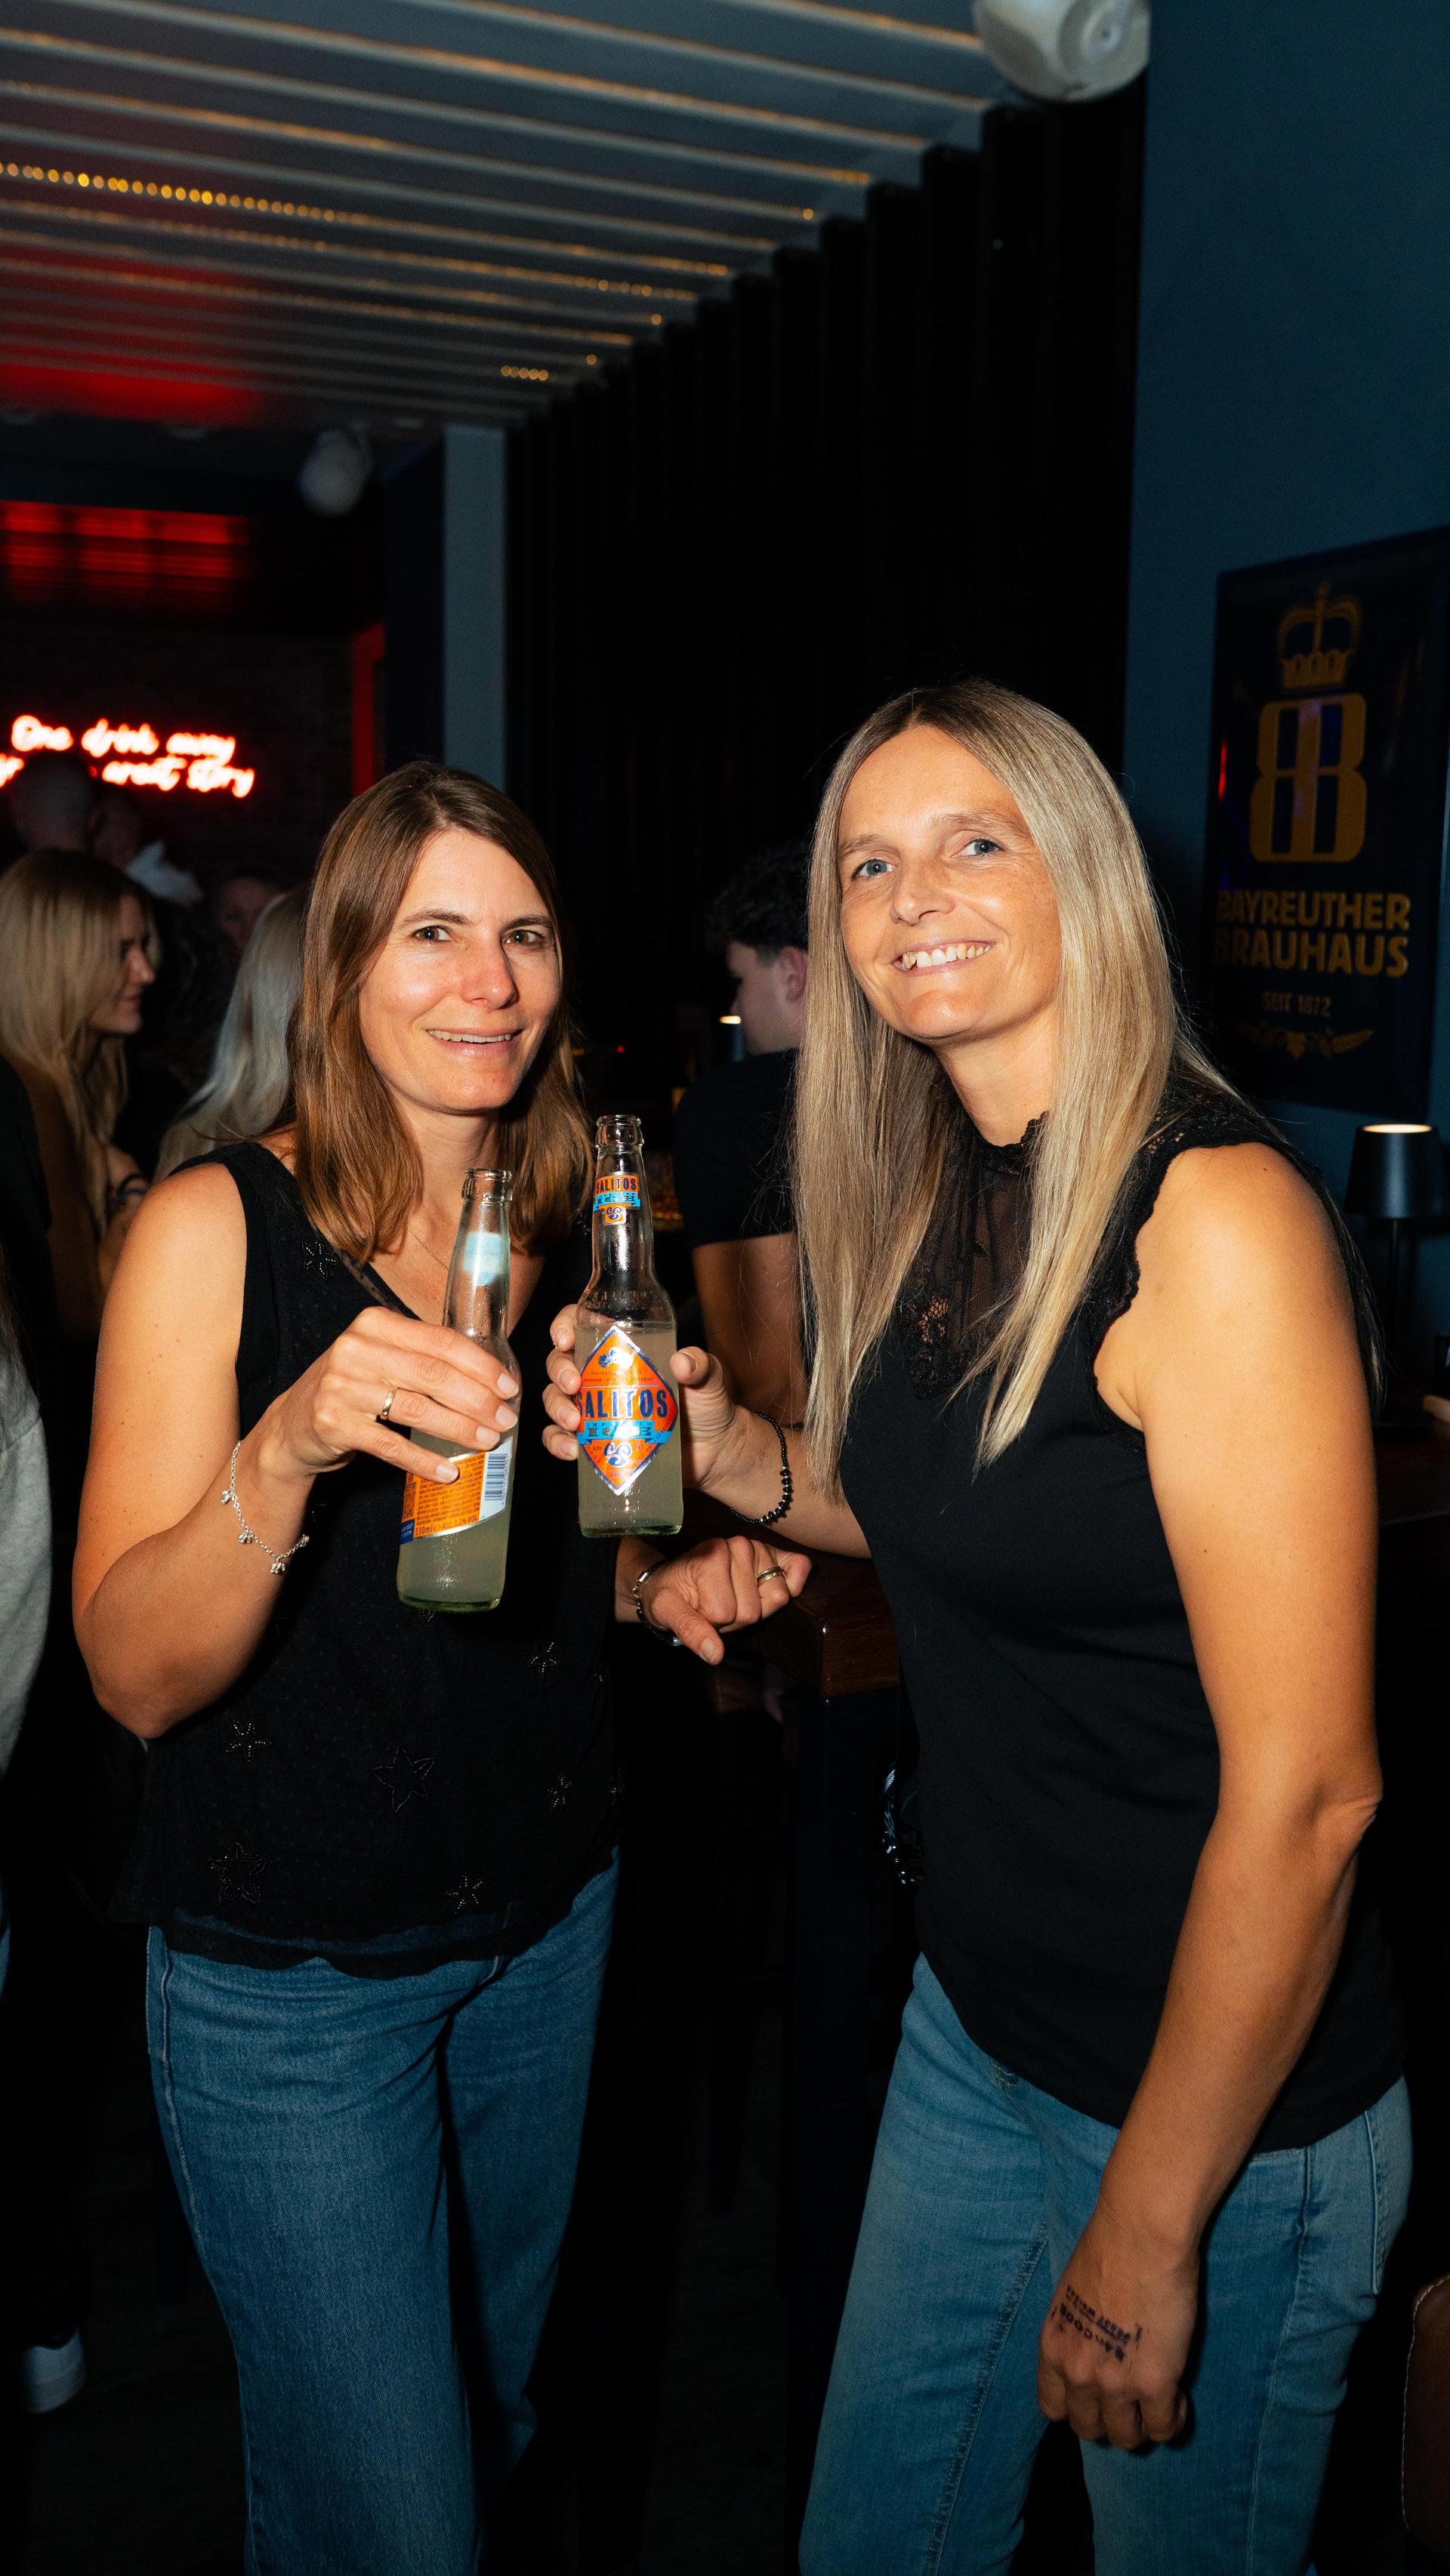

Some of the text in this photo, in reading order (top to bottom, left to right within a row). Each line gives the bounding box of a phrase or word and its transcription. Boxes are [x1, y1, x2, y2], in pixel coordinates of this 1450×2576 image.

[1216, 889, 1411, 931] BAYREUTHER
[1214, 926, 1410, 978] BRAUHAUS
[1260, 991, 1331, 1017] SEIT 1872
[595, 1178, 637, 1194] SALITOS
